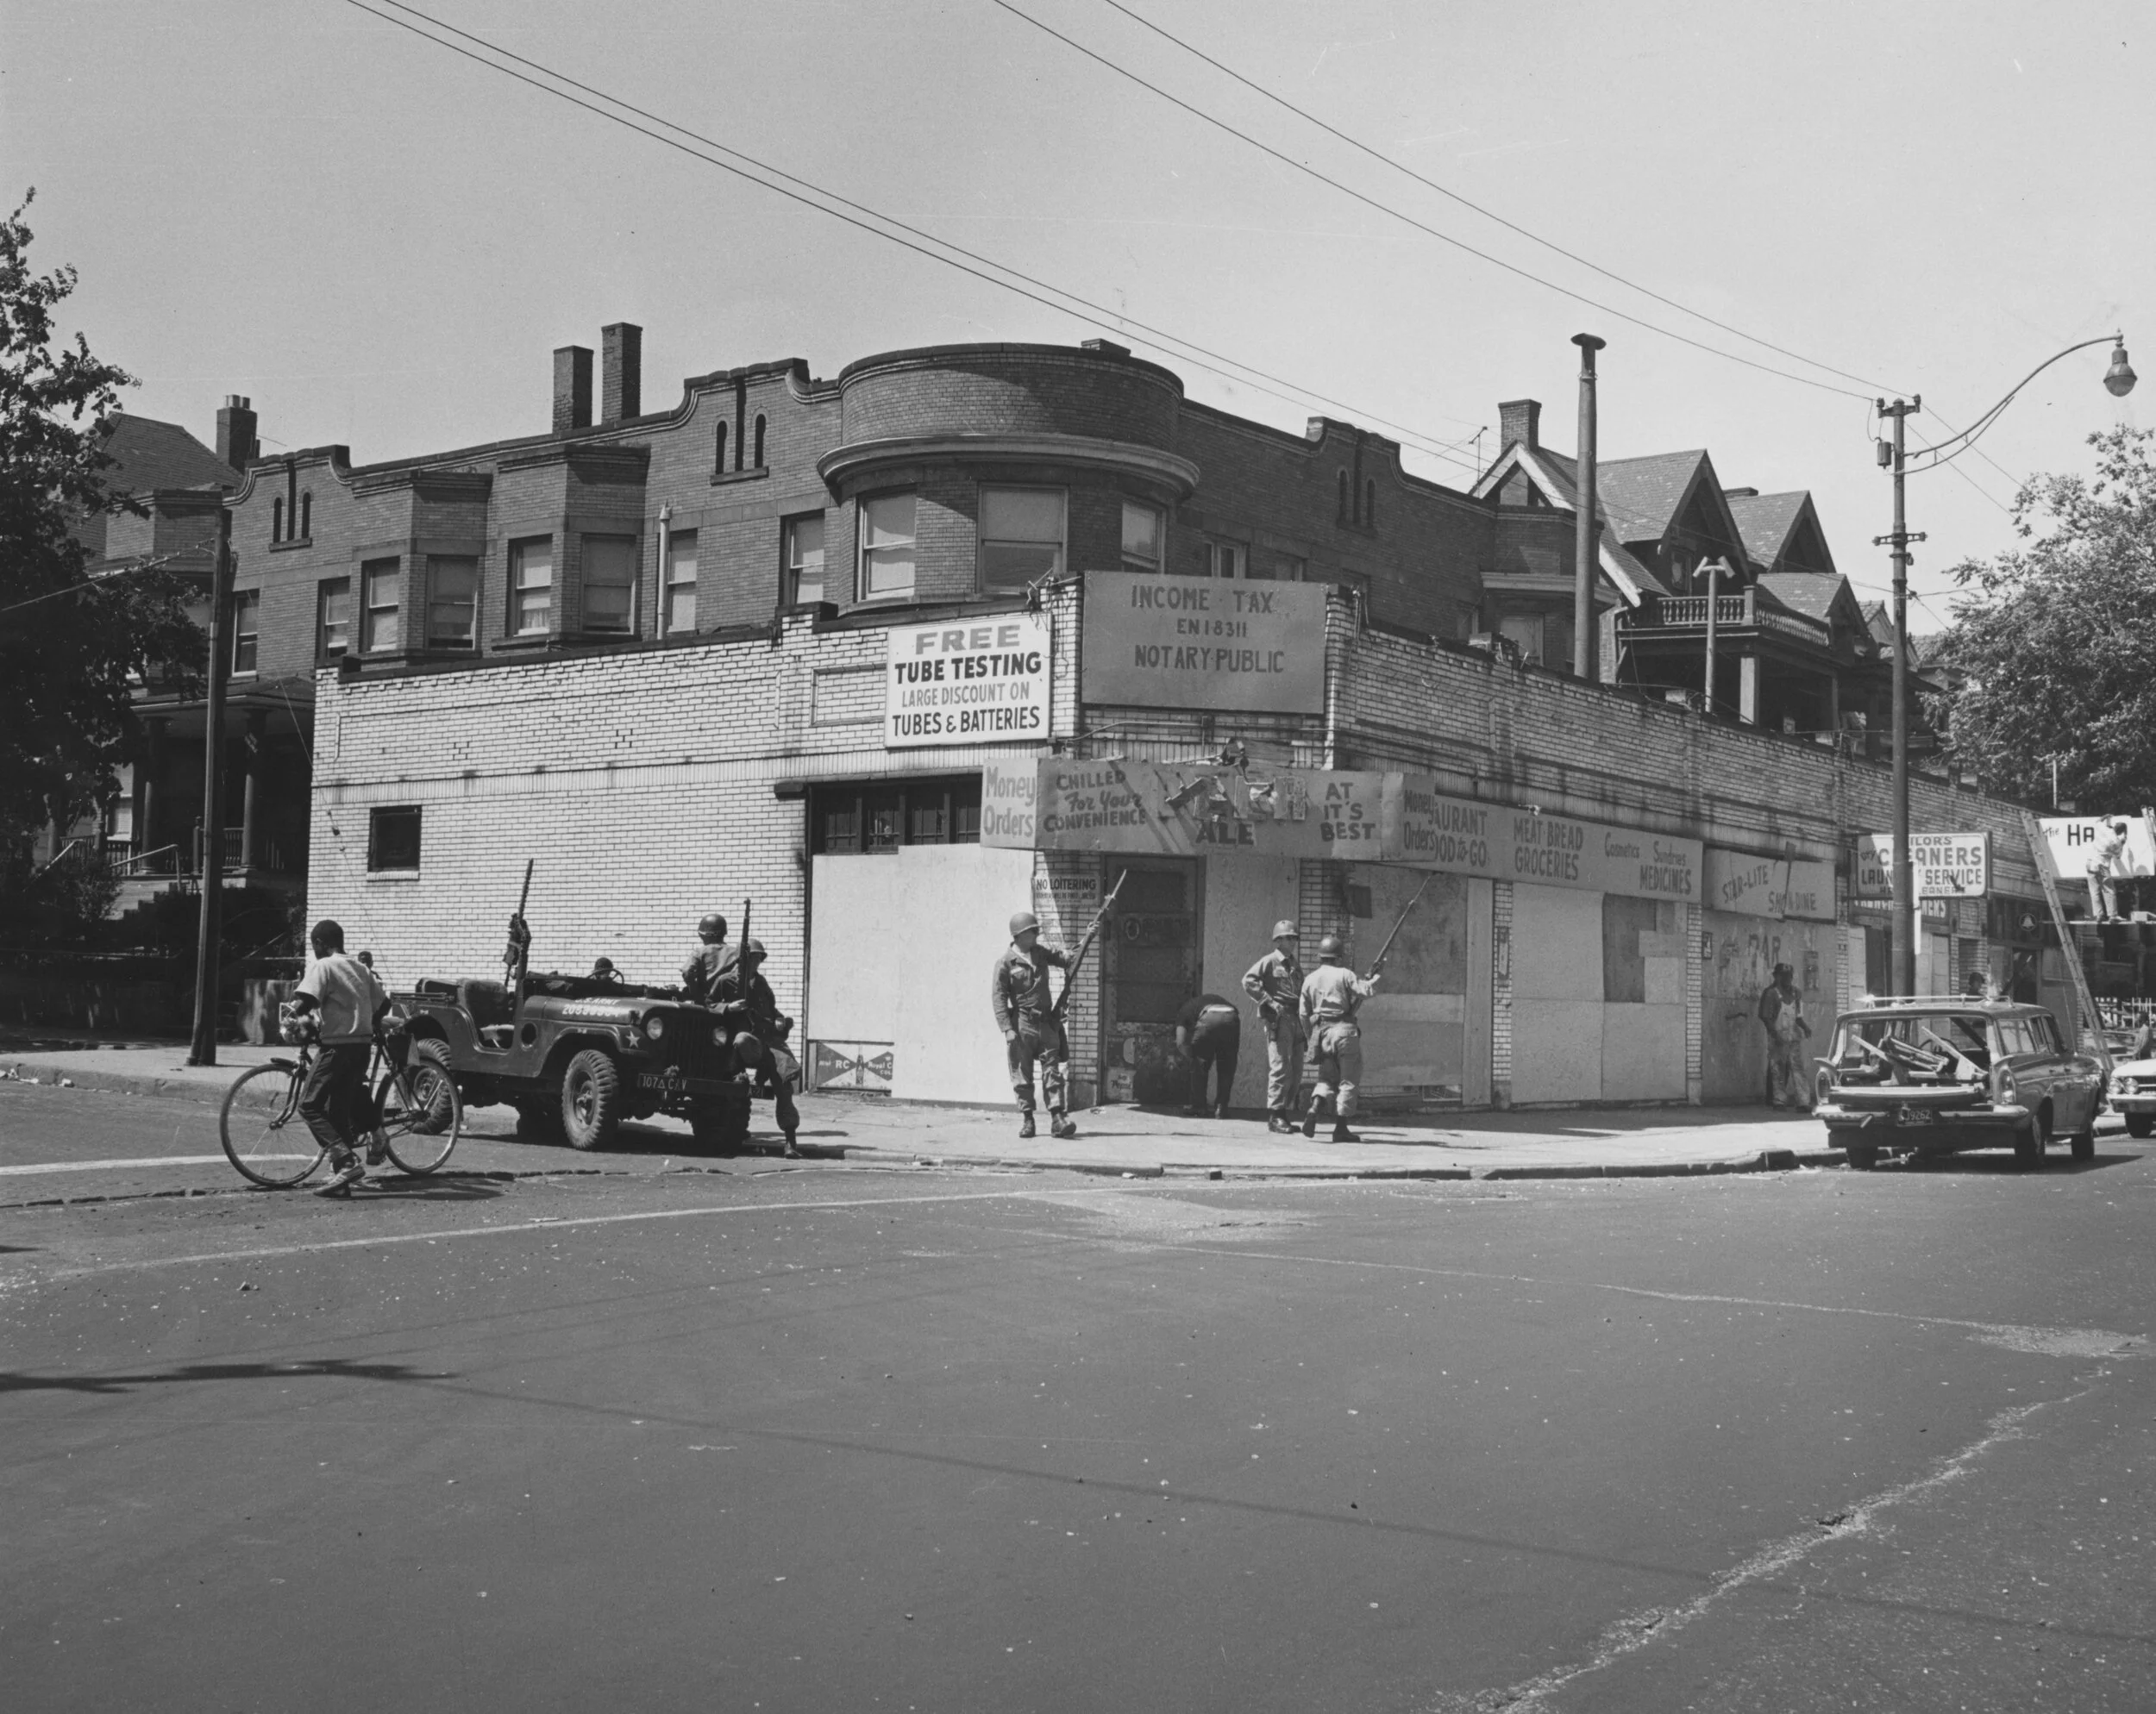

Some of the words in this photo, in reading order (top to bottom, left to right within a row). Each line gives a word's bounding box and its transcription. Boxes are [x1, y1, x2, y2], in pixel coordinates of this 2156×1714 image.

[1131, 585, 1210, 610] INCOME
[1233, 590, 1274, 614] TAX
[915, 624, 1021, 655] FREE
[894, 659, 944, 685] TUBE
[951, 651, 1041, 679] TESTING
[1134, 644, 1210, 671] NOTARY
[1216, 648, 1285, 673] PUBLIC
[902, 688, 937, 708] LARGE
[942, 683, 1006, 705] DISCOUNT
[1010, 681, 1030, 701] ON
[892, 711, 942, 736] TUBES
[945, 715, 956, 733] &
[960, 705, 1040, 733] BATTERIES
[986, 766, 1036, 807] Money
[1056, 770, 1126, 791] CHILLED
[1325, 782, 1354, 802] AT
[983, 804, 1035, 838] Orders
[1043, 808, 1148, 833] CONVENIENCE
[1323, 801, 1364, 820] IT'S
[1195, 821, 1255, 845] ALE
[1319, 822, 1376, 842] BEST
[1514, 816, 1543, 846] MEAT
[1547, 821, 1584, 852] BREAD
[1604, 831, 1640, 860] Cosmetics
[2067, 824, 2095, 846] HA
[1469, 839, 1488, 868] GO
[1514, 846, 1580, 881] GROCERIES
[1036, 879, 1048, 891] NO
[1050, 877, 1096, 891] LOITERING
[1639, 865, 1692, 896] MEDICINES
[1925, 868, 1983, 885] SERVICE
[835, 1060, 849, 1069] RC
